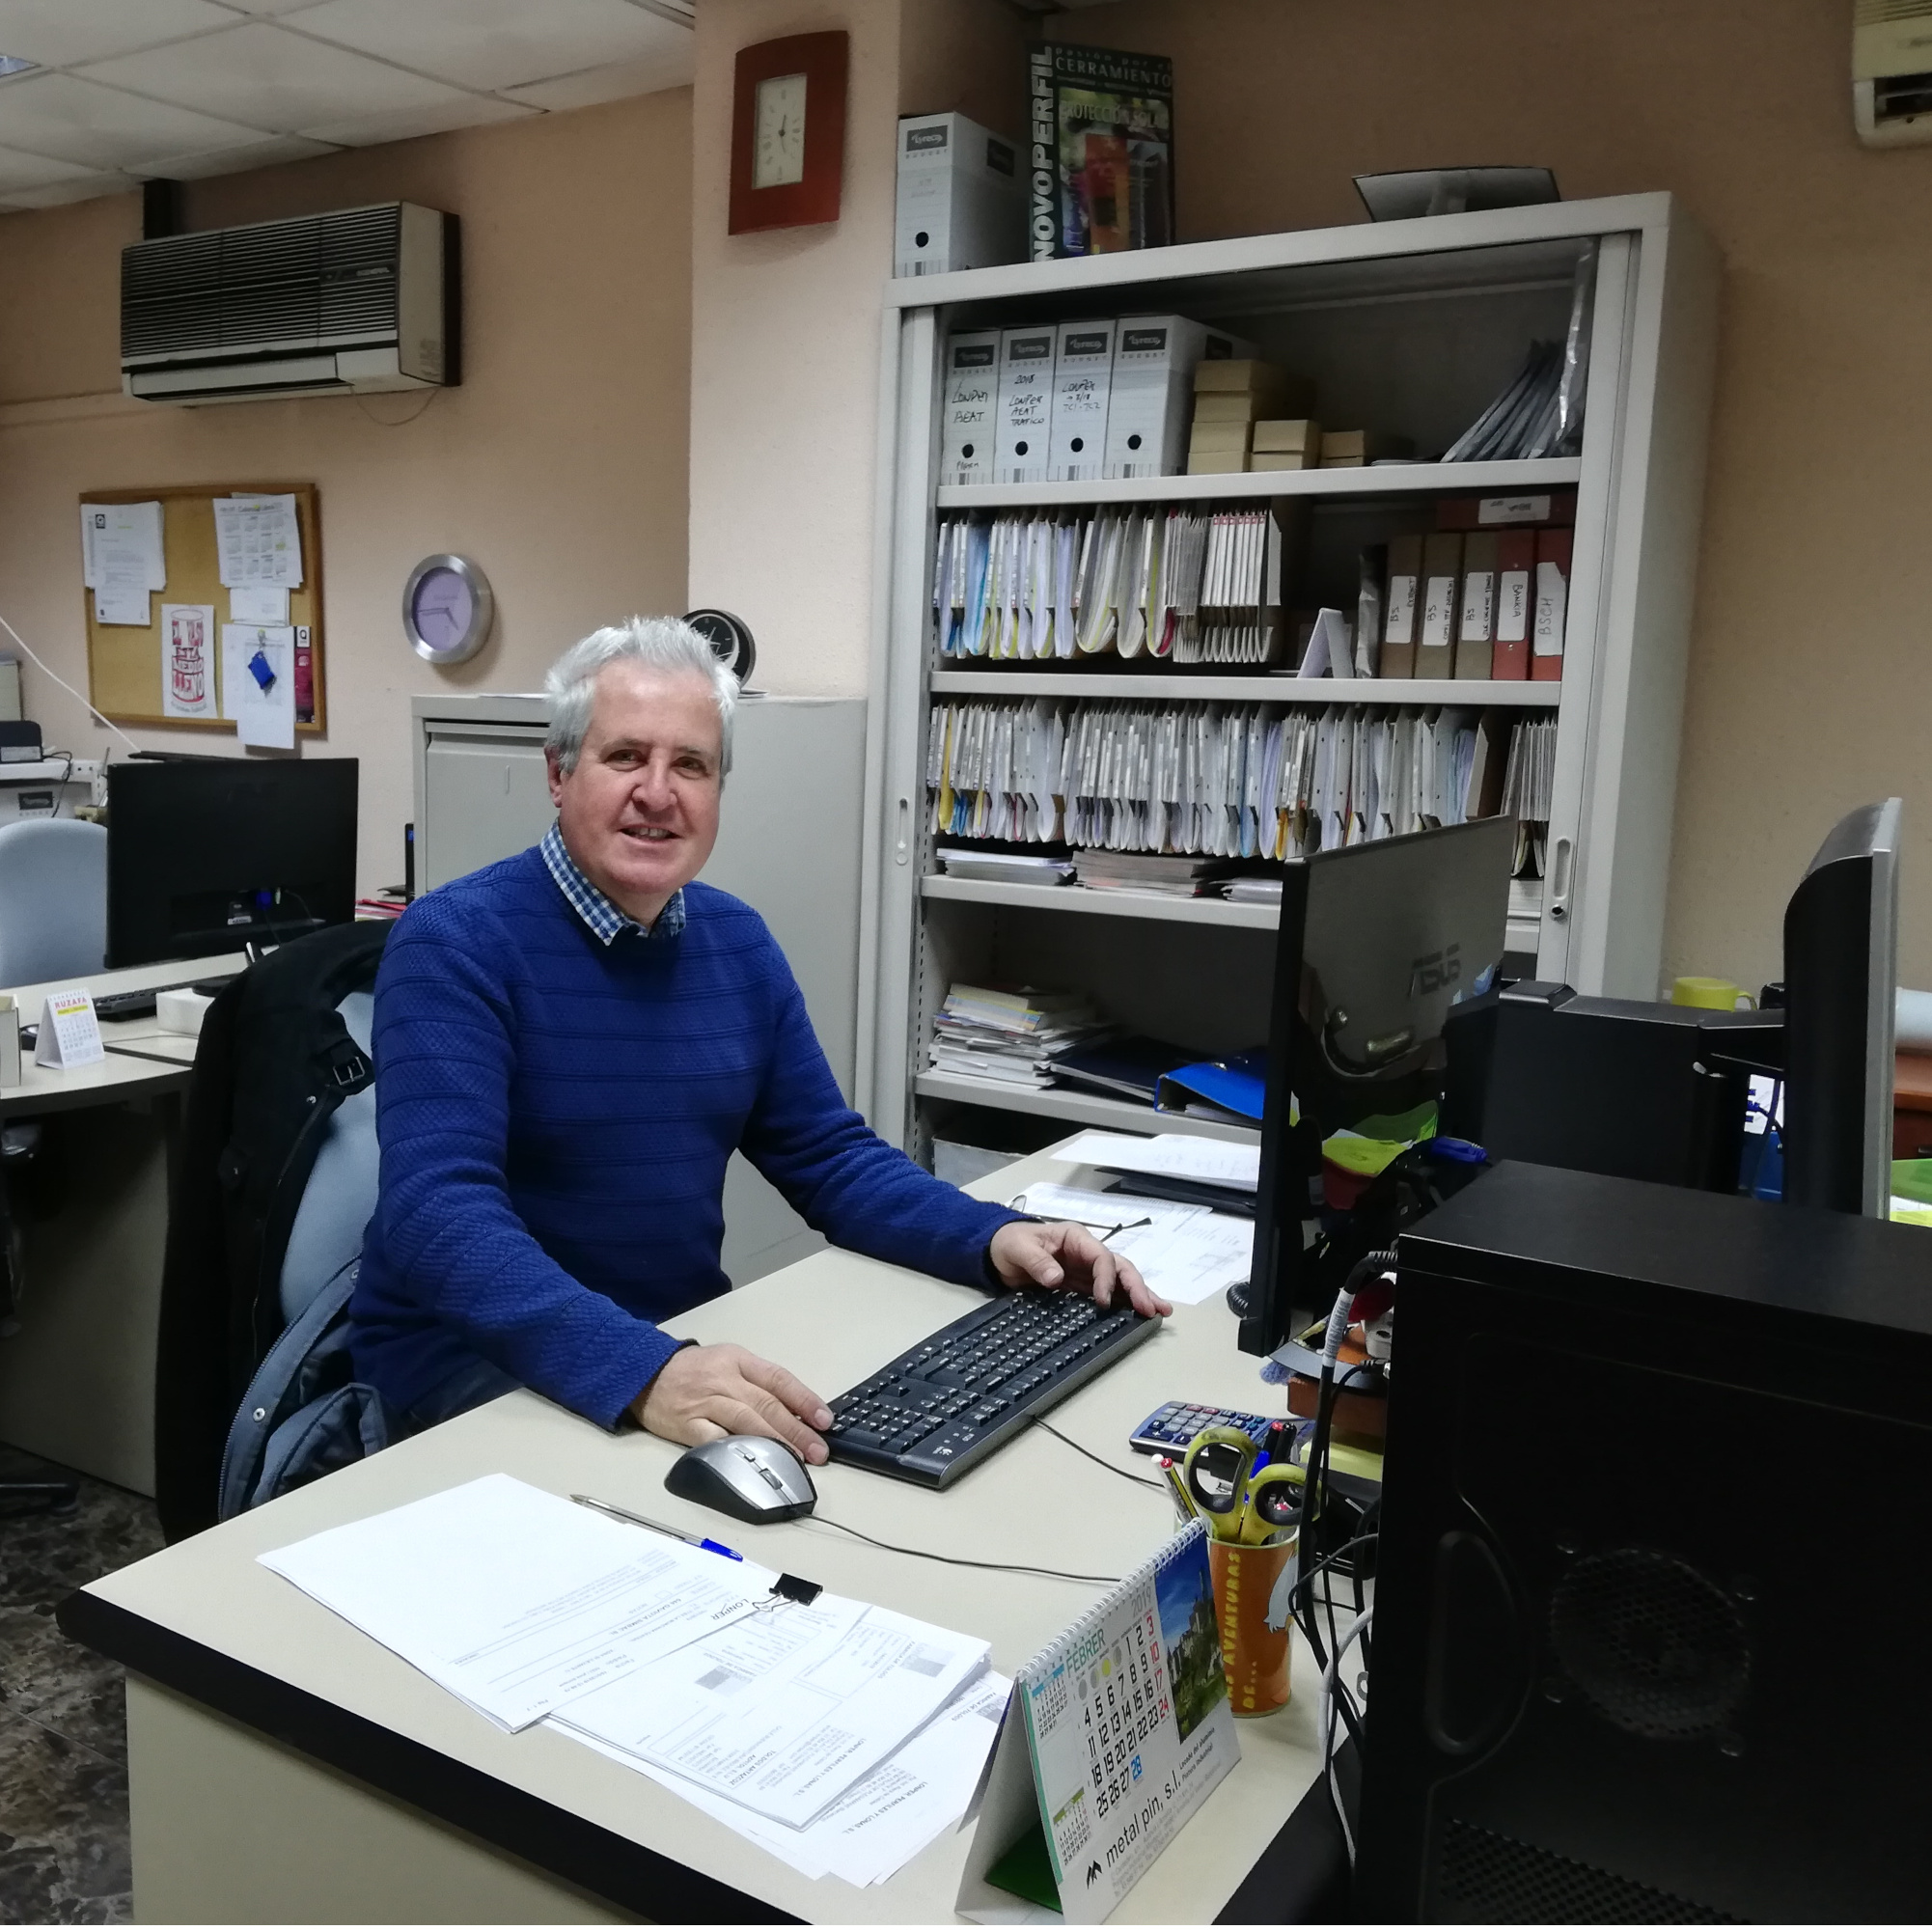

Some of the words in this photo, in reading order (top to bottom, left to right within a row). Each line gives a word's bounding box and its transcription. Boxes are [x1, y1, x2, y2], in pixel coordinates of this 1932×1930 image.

[1055, 57, 1172, 88] CERRAMIENTO
[1031, 45, 1055, 262] NOVOPERFIL
[1406, 942, 1462, 997] ASUS
[55, 995, 88, 1009] RUZAFA
[710, 1598, 749, 1620] LONPER
[1066, 1628, 1106, 1679] FEBRER
[1131, 1585, 1152, 1619] 2019
[1126, 1636, 1132, 1656] 1
[1136, 1625, 1144, 1646] 2
[1146, 1615, 1154, 1637] 3
[1223, 1552, 1241, 1666] AVENTURAS
[1085, 1707, 1091, 1727] 4
[1094, 1695, 1104, 1719] 5
[1107, 1684, 1115, 1706] 6
[1118, 1672, 1124, 1696] 7
[1129, 1663, 1137, 1685] 8
[1141, 1652, 1148, 1673] 9
[1149, 1640, 1160, 1665] 10
[1088, 1735, 1096, 1758] 11
[1098, 1722, 1110, 1748] 12
[1110, 1711, 1120, 1736] 13
[1121, 1699, 1132, 1724] 14
[1132, 1689, 1143, 1713] 15
[1144, 1678, 1153, 1702] 16
[1154, 1668, 1163, 1692] 17
[754, 1751, 776, 1766] TOLDOS
[823, 1754, 847, 1774] PERFILES
[1090, 1762, 1103, 1789] 18
[1103, 1751, 1115, 1776] 19
[1115, 1738, 1126, 1765] 20
[1126, 1726, 1137, 1752] 21
[1137, 1716, 1148, 1742] 22
[1147, 1704, 1159, 1730] 23
[1158, 1693, 1170, 1720] 24
[878, 1796, 905, 1815] PERFILES
[1096, 1791, 1109, 1819] 25
[1108, 1778, 1120, 1806] 26
[1119, 1766, 1130, 1793] 27
[1130, 1753, 1143, 1781] 28
[1106, 1813, 1141, 1868] metal
[1141, 1795, 1164, 1832] pin,
[1164, 1769, 1181, 1801] s.l.
